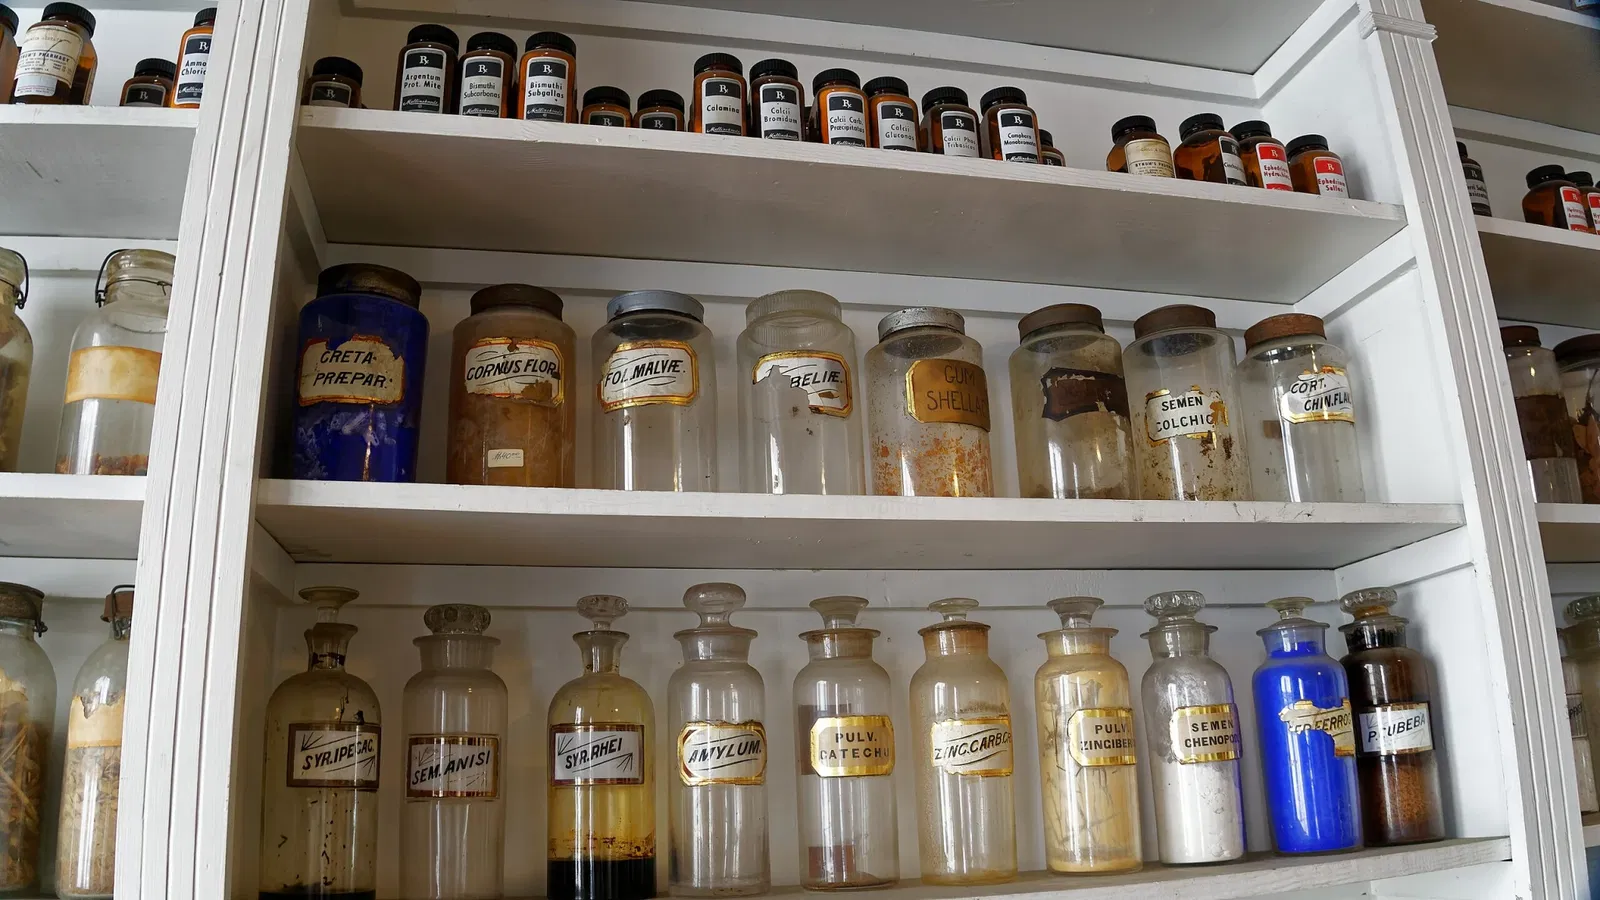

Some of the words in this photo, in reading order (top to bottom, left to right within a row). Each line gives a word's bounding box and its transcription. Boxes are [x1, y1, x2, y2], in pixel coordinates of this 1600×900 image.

[405, 73, 441, 82] Argentum
[469, 83, 496, 91] Bismuthi
[530, 81, 563, 91] Bismuthi
[527, 90, 564, 99] Subgallas
[706, 104, 740, 114] Calamina
[763, 115, 798, 124] Bromidum
[466, 357, 523, 381] CORNUS
[1290, 377, 1327, 395] CORT.
[1161, 395, 1204, 412] SEMEN
[1191, 719, 1234, 733] SEMEN
[835, 731, 877, 743] PULV.
